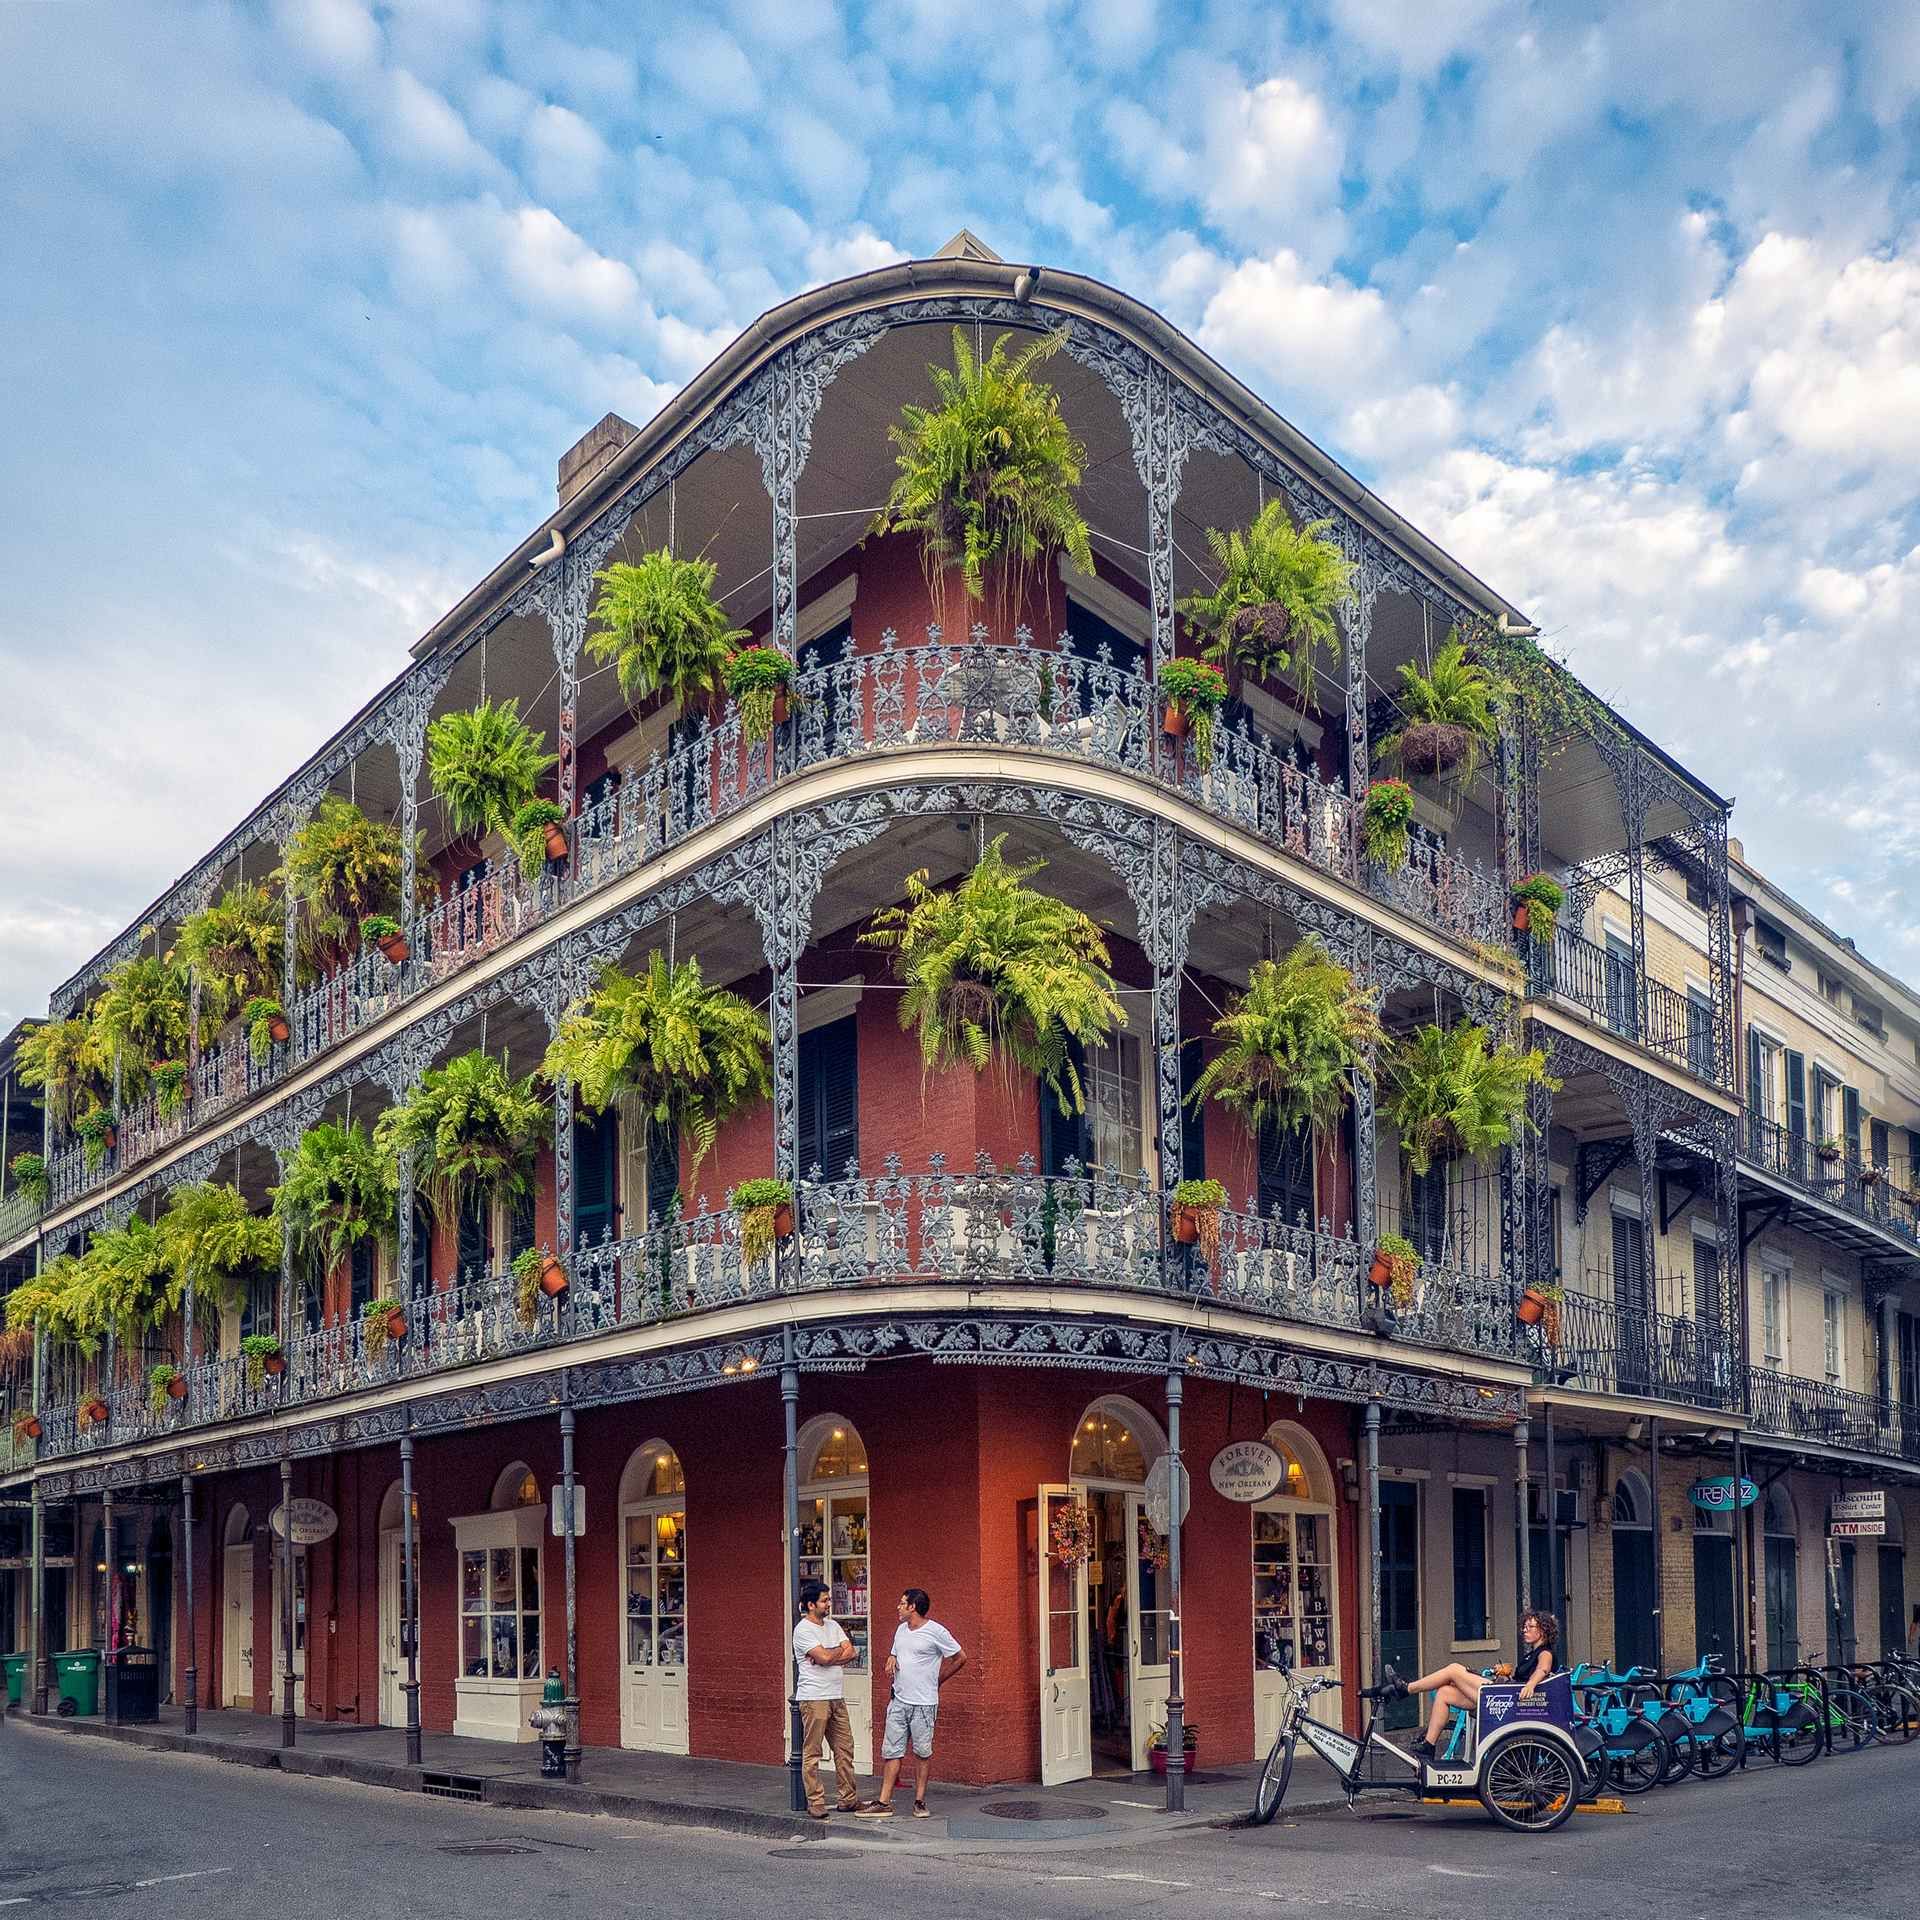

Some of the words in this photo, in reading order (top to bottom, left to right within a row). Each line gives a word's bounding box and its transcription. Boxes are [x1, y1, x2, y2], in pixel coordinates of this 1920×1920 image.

[1219, 1447, 1272, 1467] FOREVER
[1219, 1480, 1235, 1488] NEW
[1237, 1480, 1271, 1488] ORLEANS
[1833, 1493, 1882, 1503] Discount
[1832, 1523, 1859, 1534] ATM
[1860, 1523, 1883, 1533] INSIDE
[1486, 1694, 1514, 1708] Vintage
[1437, 1773, 1463, 1785] PC-22
